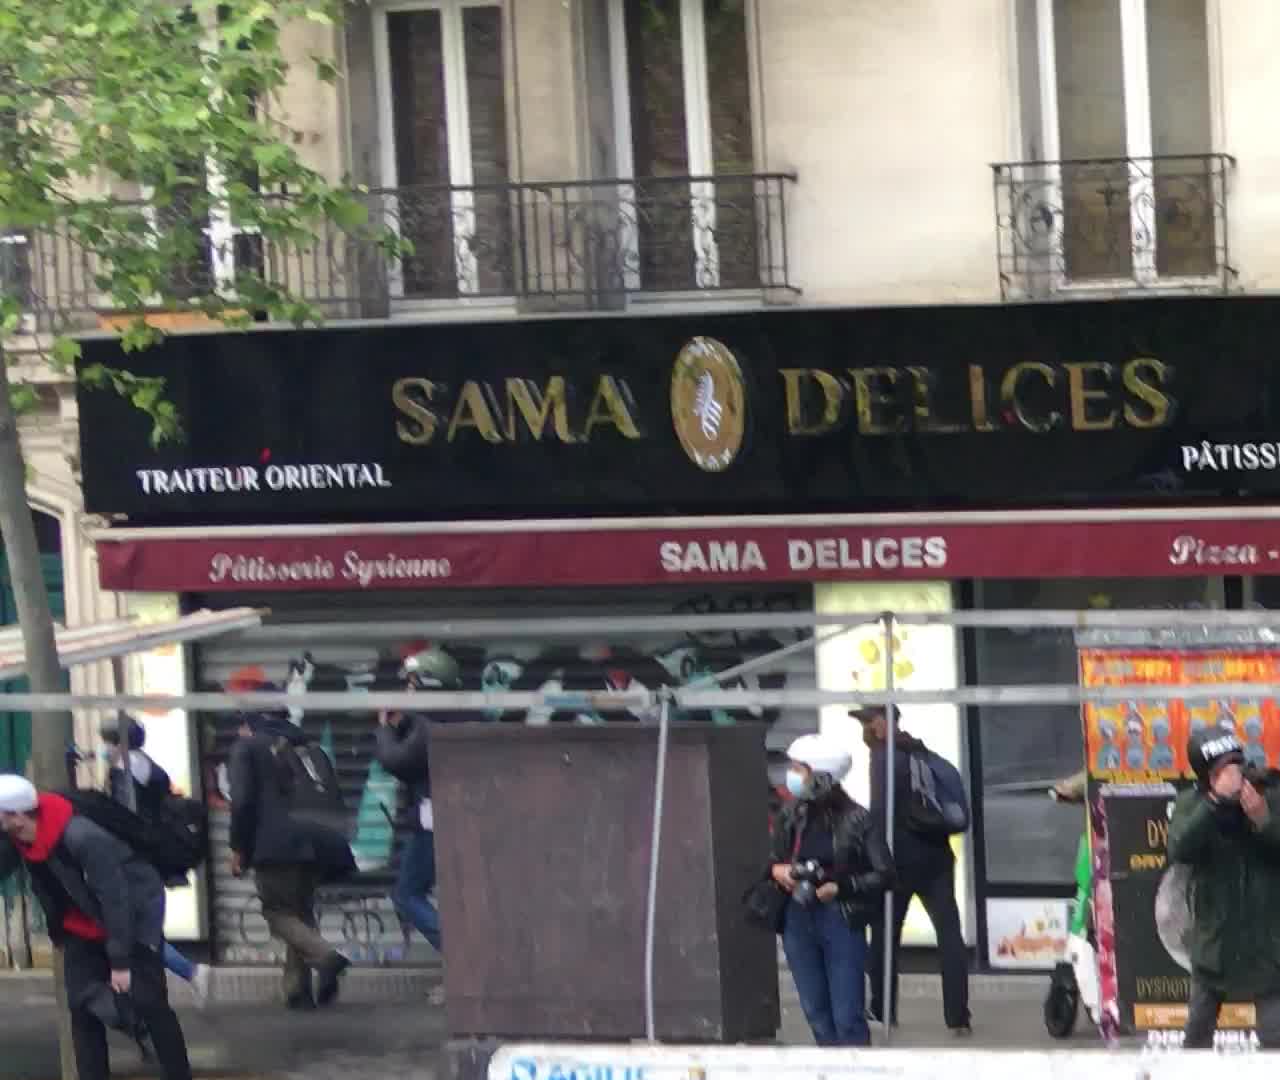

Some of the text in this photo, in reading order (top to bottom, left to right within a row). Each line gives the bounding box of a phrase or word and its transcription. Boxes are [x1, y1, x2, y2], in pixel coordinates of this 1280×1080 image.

[392, 356, 1172, 446] SAMA DELICES
[136, 462, 392, 494] TRAITEUR ORIENTAL
[660, 536, 948, 572] SAMA DELICES
[1169, 534, 1257, 565] Pizza
[341, 550, 451, 588] Syrienne
